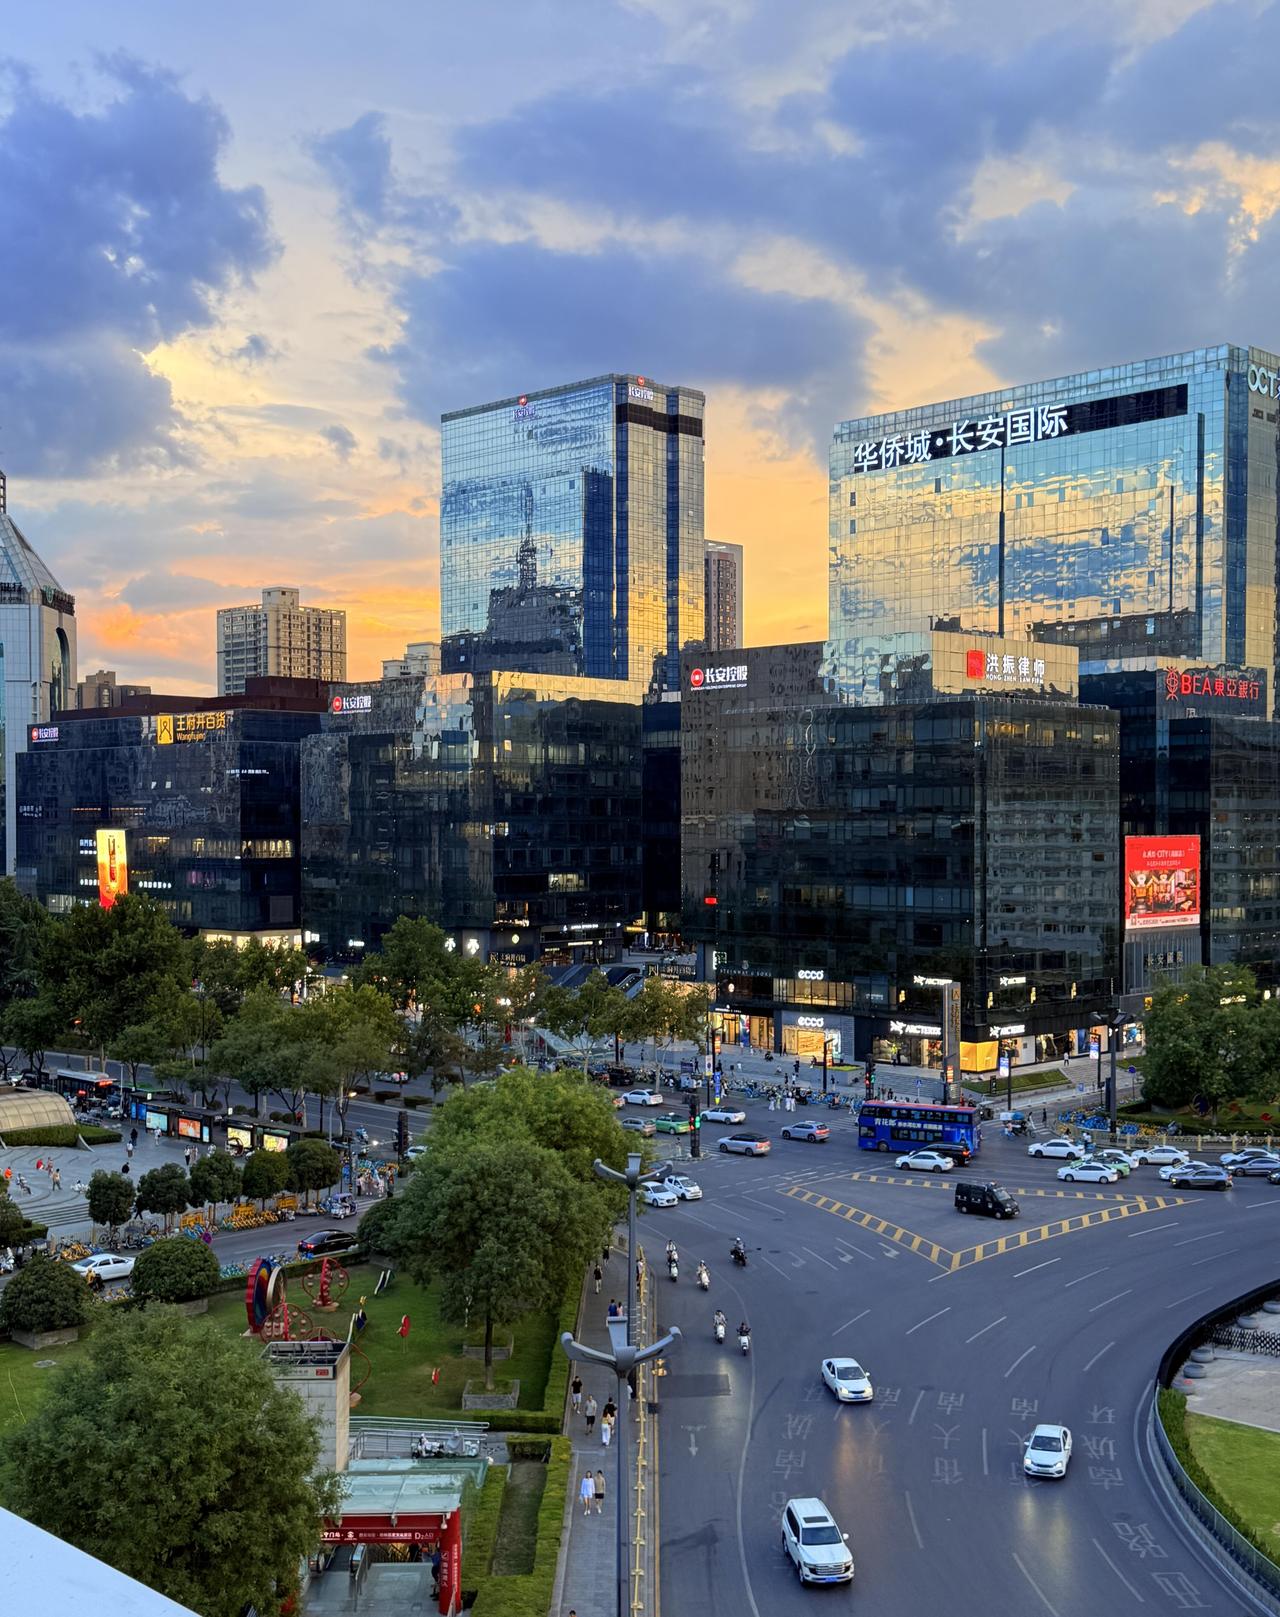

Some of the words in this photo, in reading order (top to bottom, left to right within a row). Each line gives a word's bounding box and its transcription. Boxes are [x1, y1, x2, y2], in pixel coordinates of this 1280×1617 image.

[854, 403, 1069, 472] 华侨城·长安国际
[705, 665, 748, 683] 长安控股
[986, 652, 1045, 678] 洪振律师
[176, 711, 226, 731] 王府井百货
[798, 969, 825, 981] ecco
[798, 1015, 825, 1027] ecco
